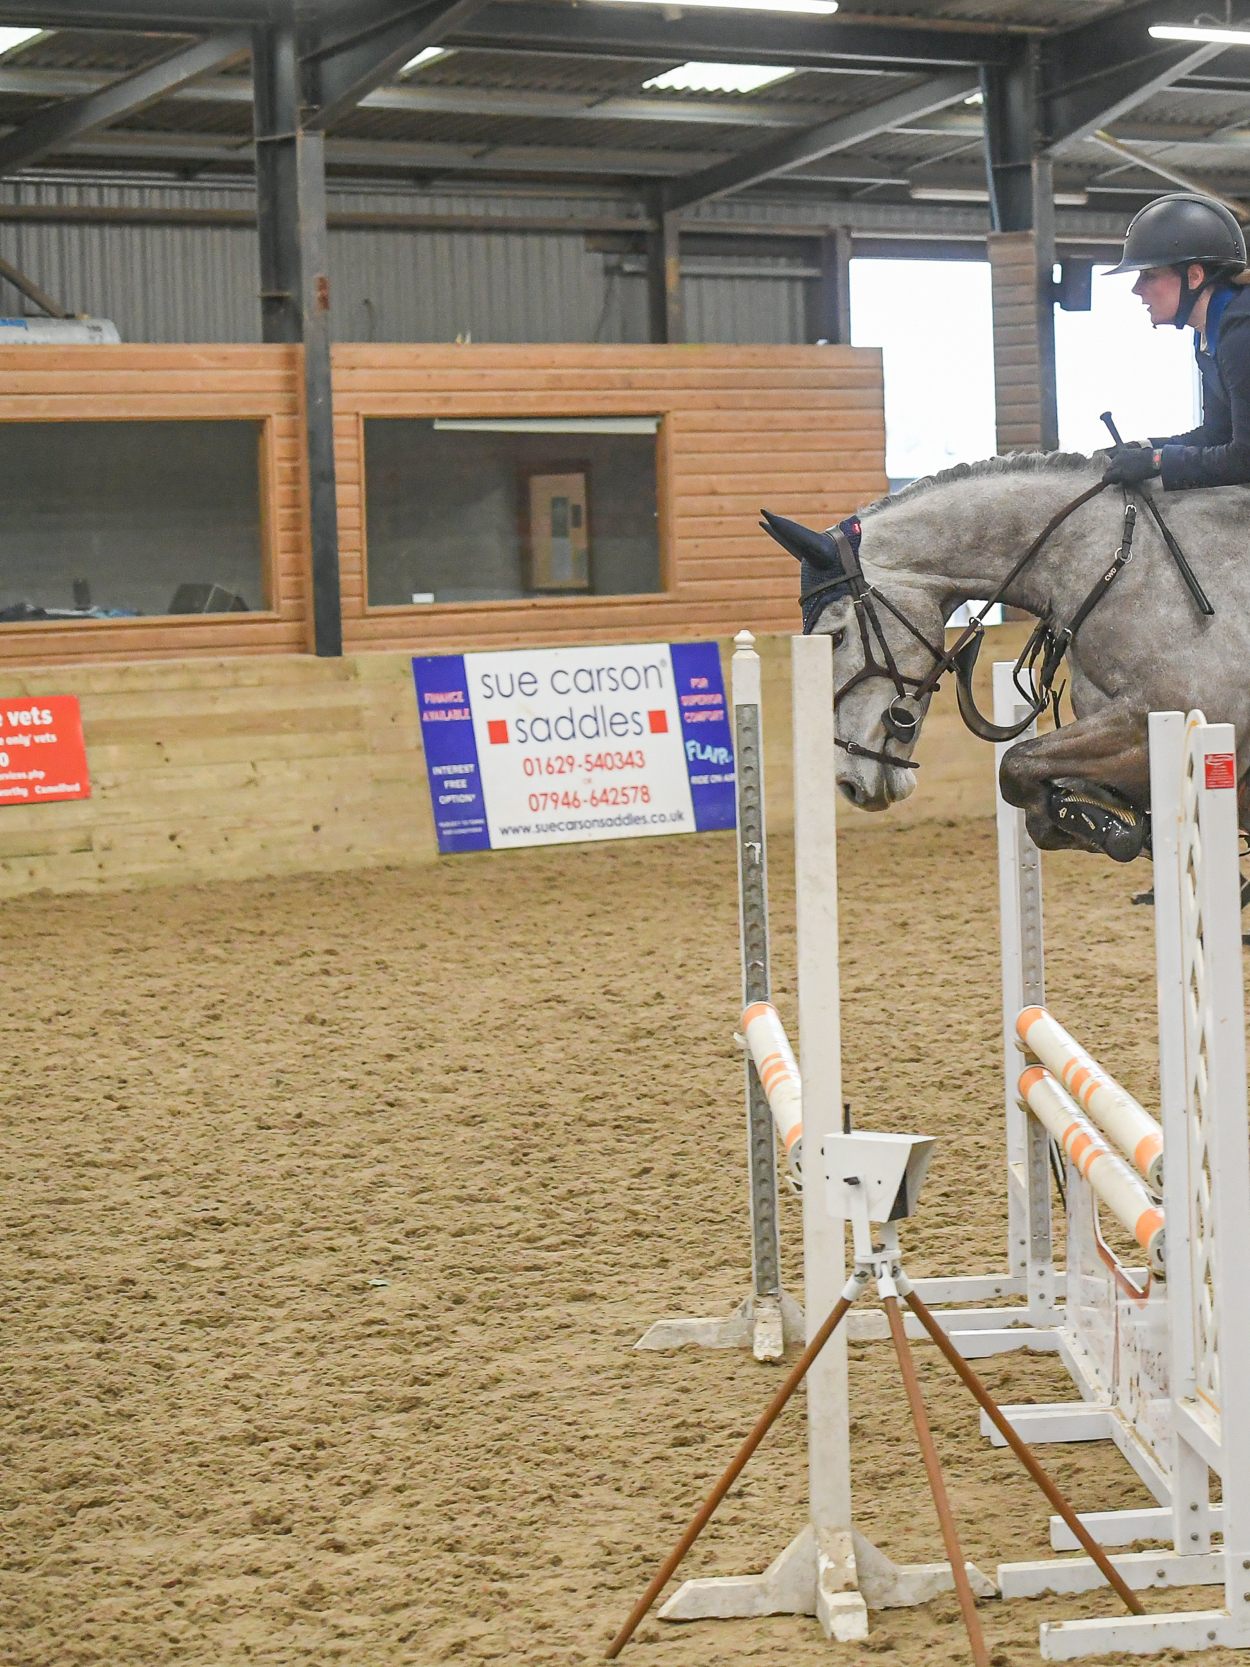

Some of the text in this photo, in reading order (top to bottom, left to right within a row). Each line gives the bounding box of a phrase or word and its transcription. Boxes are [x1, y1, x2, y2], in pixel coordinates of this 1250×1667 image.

[481, 664, 663, 699] sue carson
[424, 691, 465, 704] FINANCE
[7, 706, 53, 727] vets
[422, 708, 471, 722] AVAILABLE
[515, 704, 644, 744] saddles
[432, 764, 475, 776] INTEREST
[523, 750, 646, 776] 01629-540343
[444, 778, 467, 790] FREE
[528, 785, 652, 812] 07946-642578
[499, 811, 685, 835] www.suecarsonsaddles.co.uk
